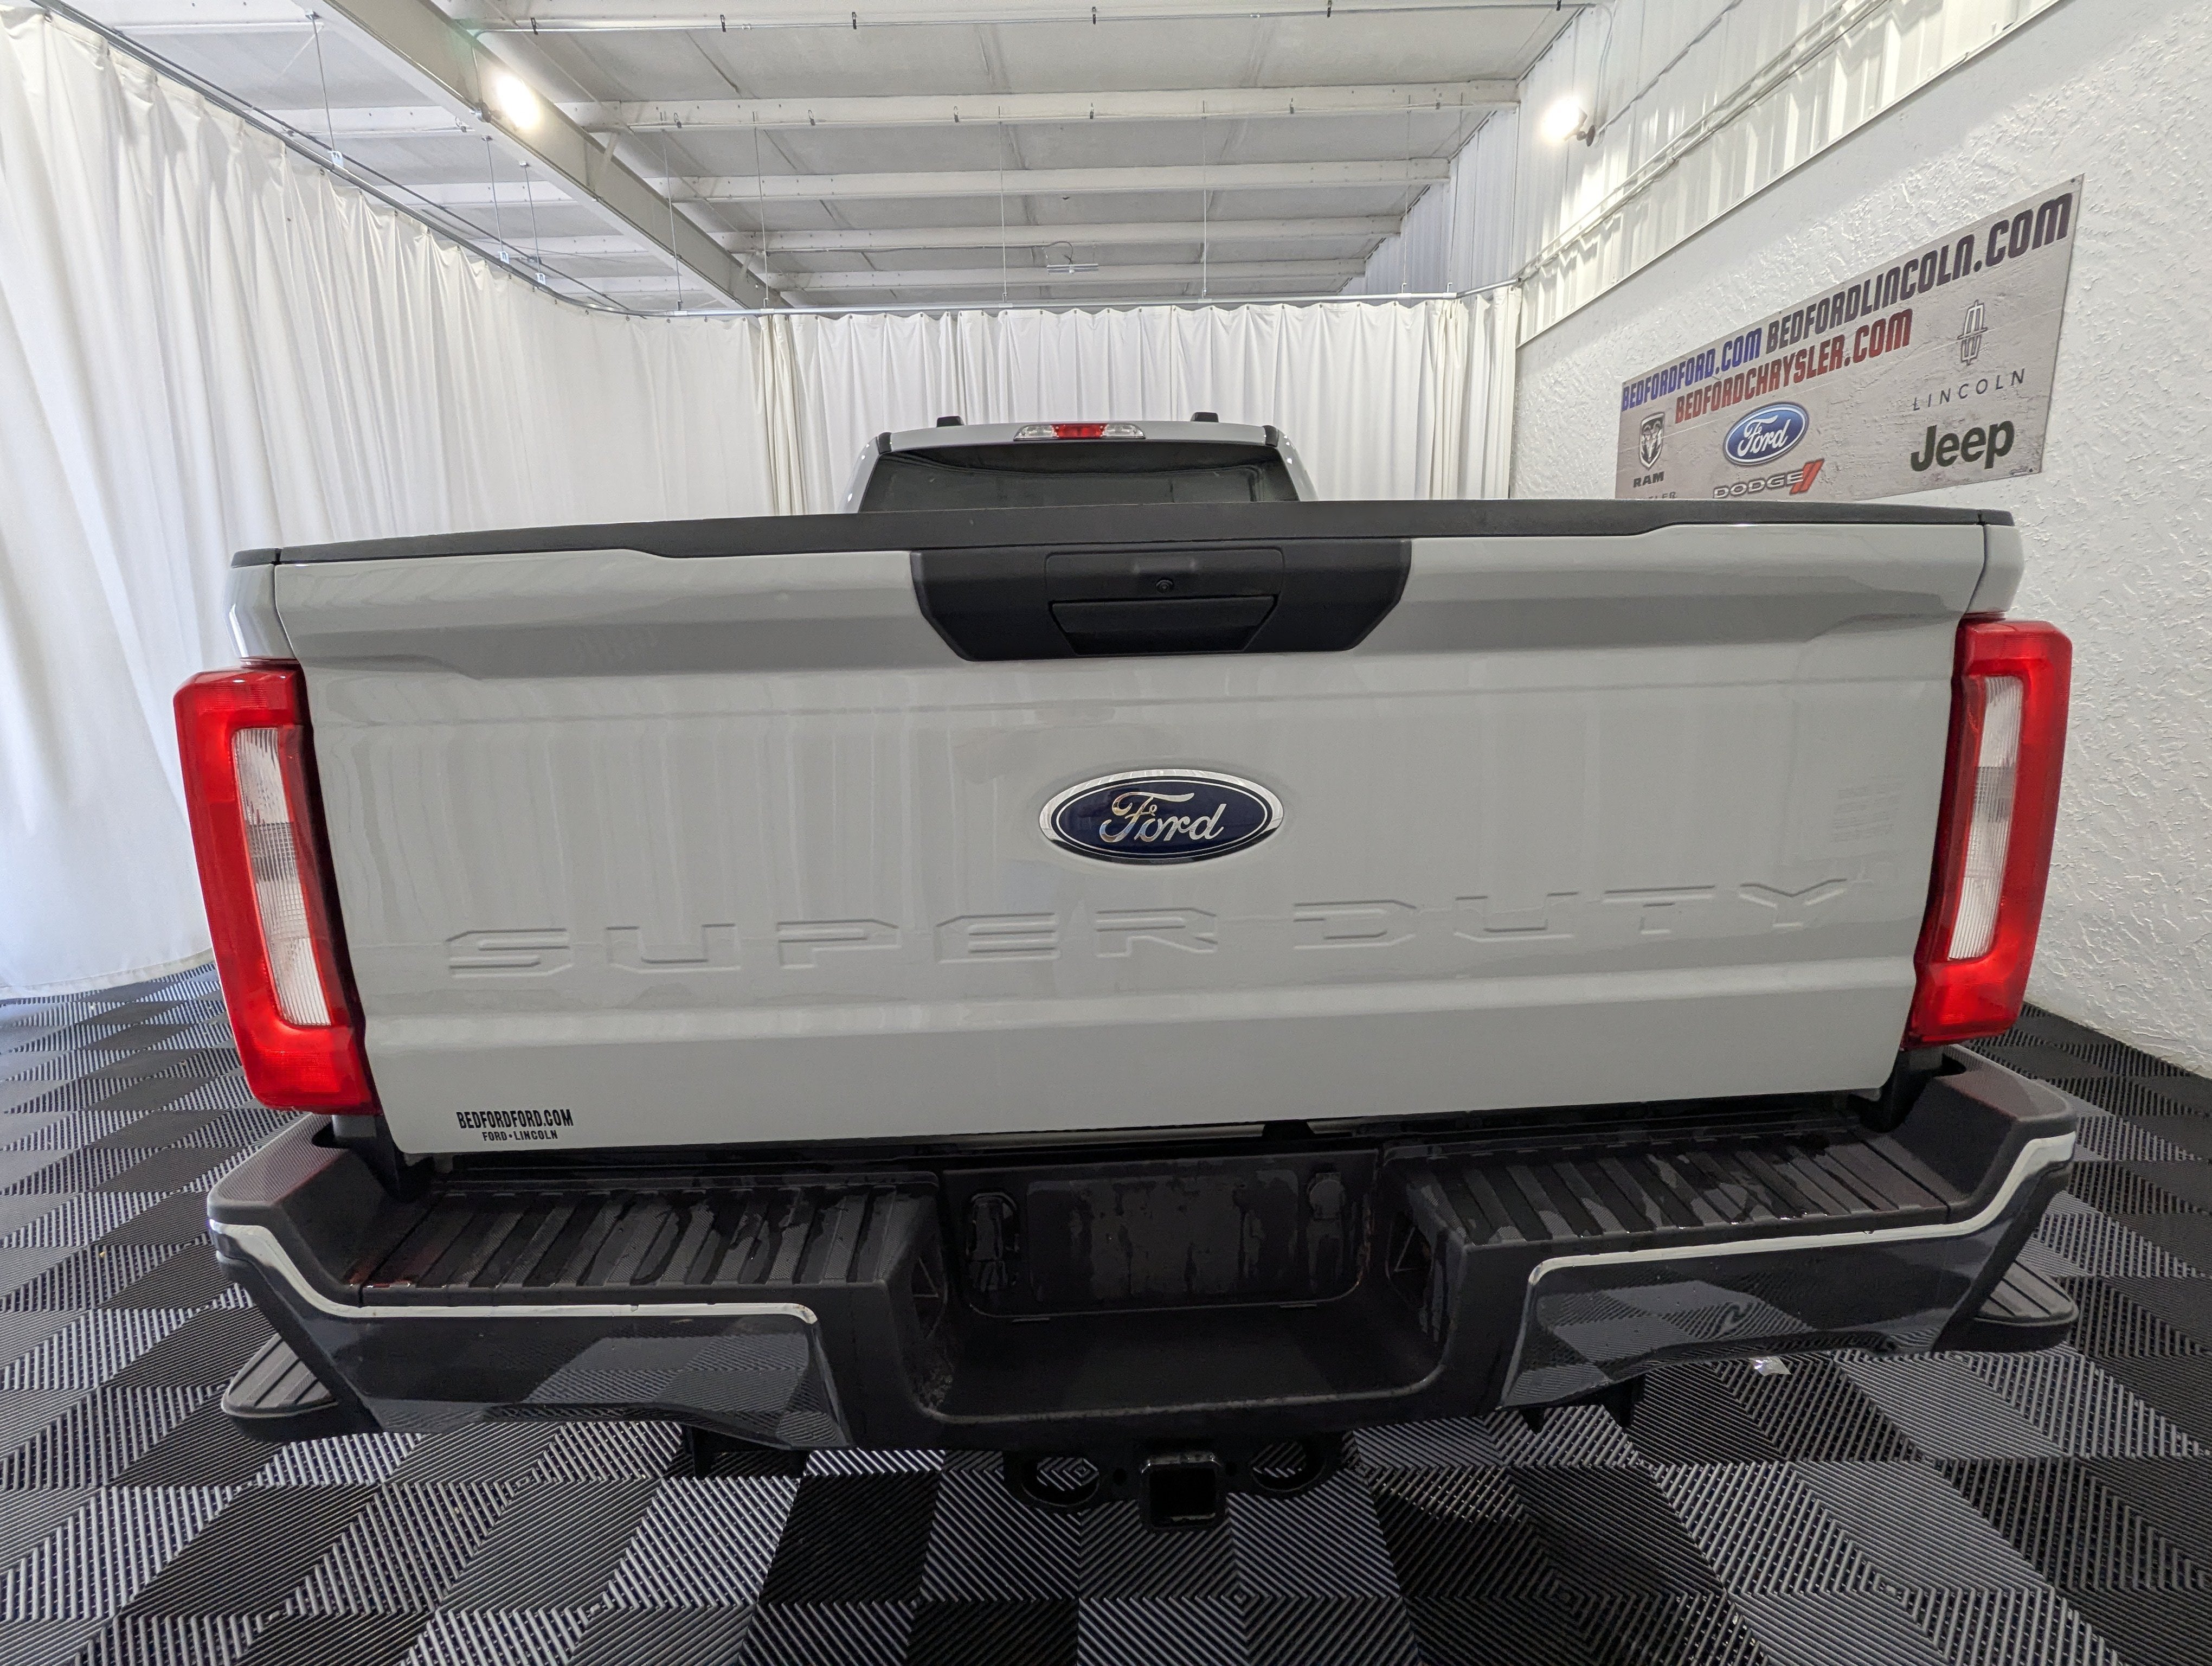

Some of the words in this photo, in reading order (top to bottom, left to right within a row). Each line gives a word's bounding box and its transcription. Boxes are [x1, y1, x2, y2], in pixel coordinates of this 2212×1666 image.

[1621, 328, 1762, 412] BEDFORDFORD.COM
[1766, 192, 2074, 355] BEDFORDLINCOLN.COM
[1675, 309, 1913, 425] BEDFORDCHRYSLER.COM
[1912, 368, 2025, 411] LINCOLN
[1737, 414, 1792, 457] Ford
[1910, 420, 2015, 472] Jeep
[1633, 471, 1664, 488] RAM
[1713, 469, 1804, 499] DODGE
[1098, 791, 1227, 843] Ford
[446, 908, 1219, 978] SUPER
[1293, 878, 1848, 950] DUTY
[456, 1108, 574, 1129] BEDFORDFORD.COM
